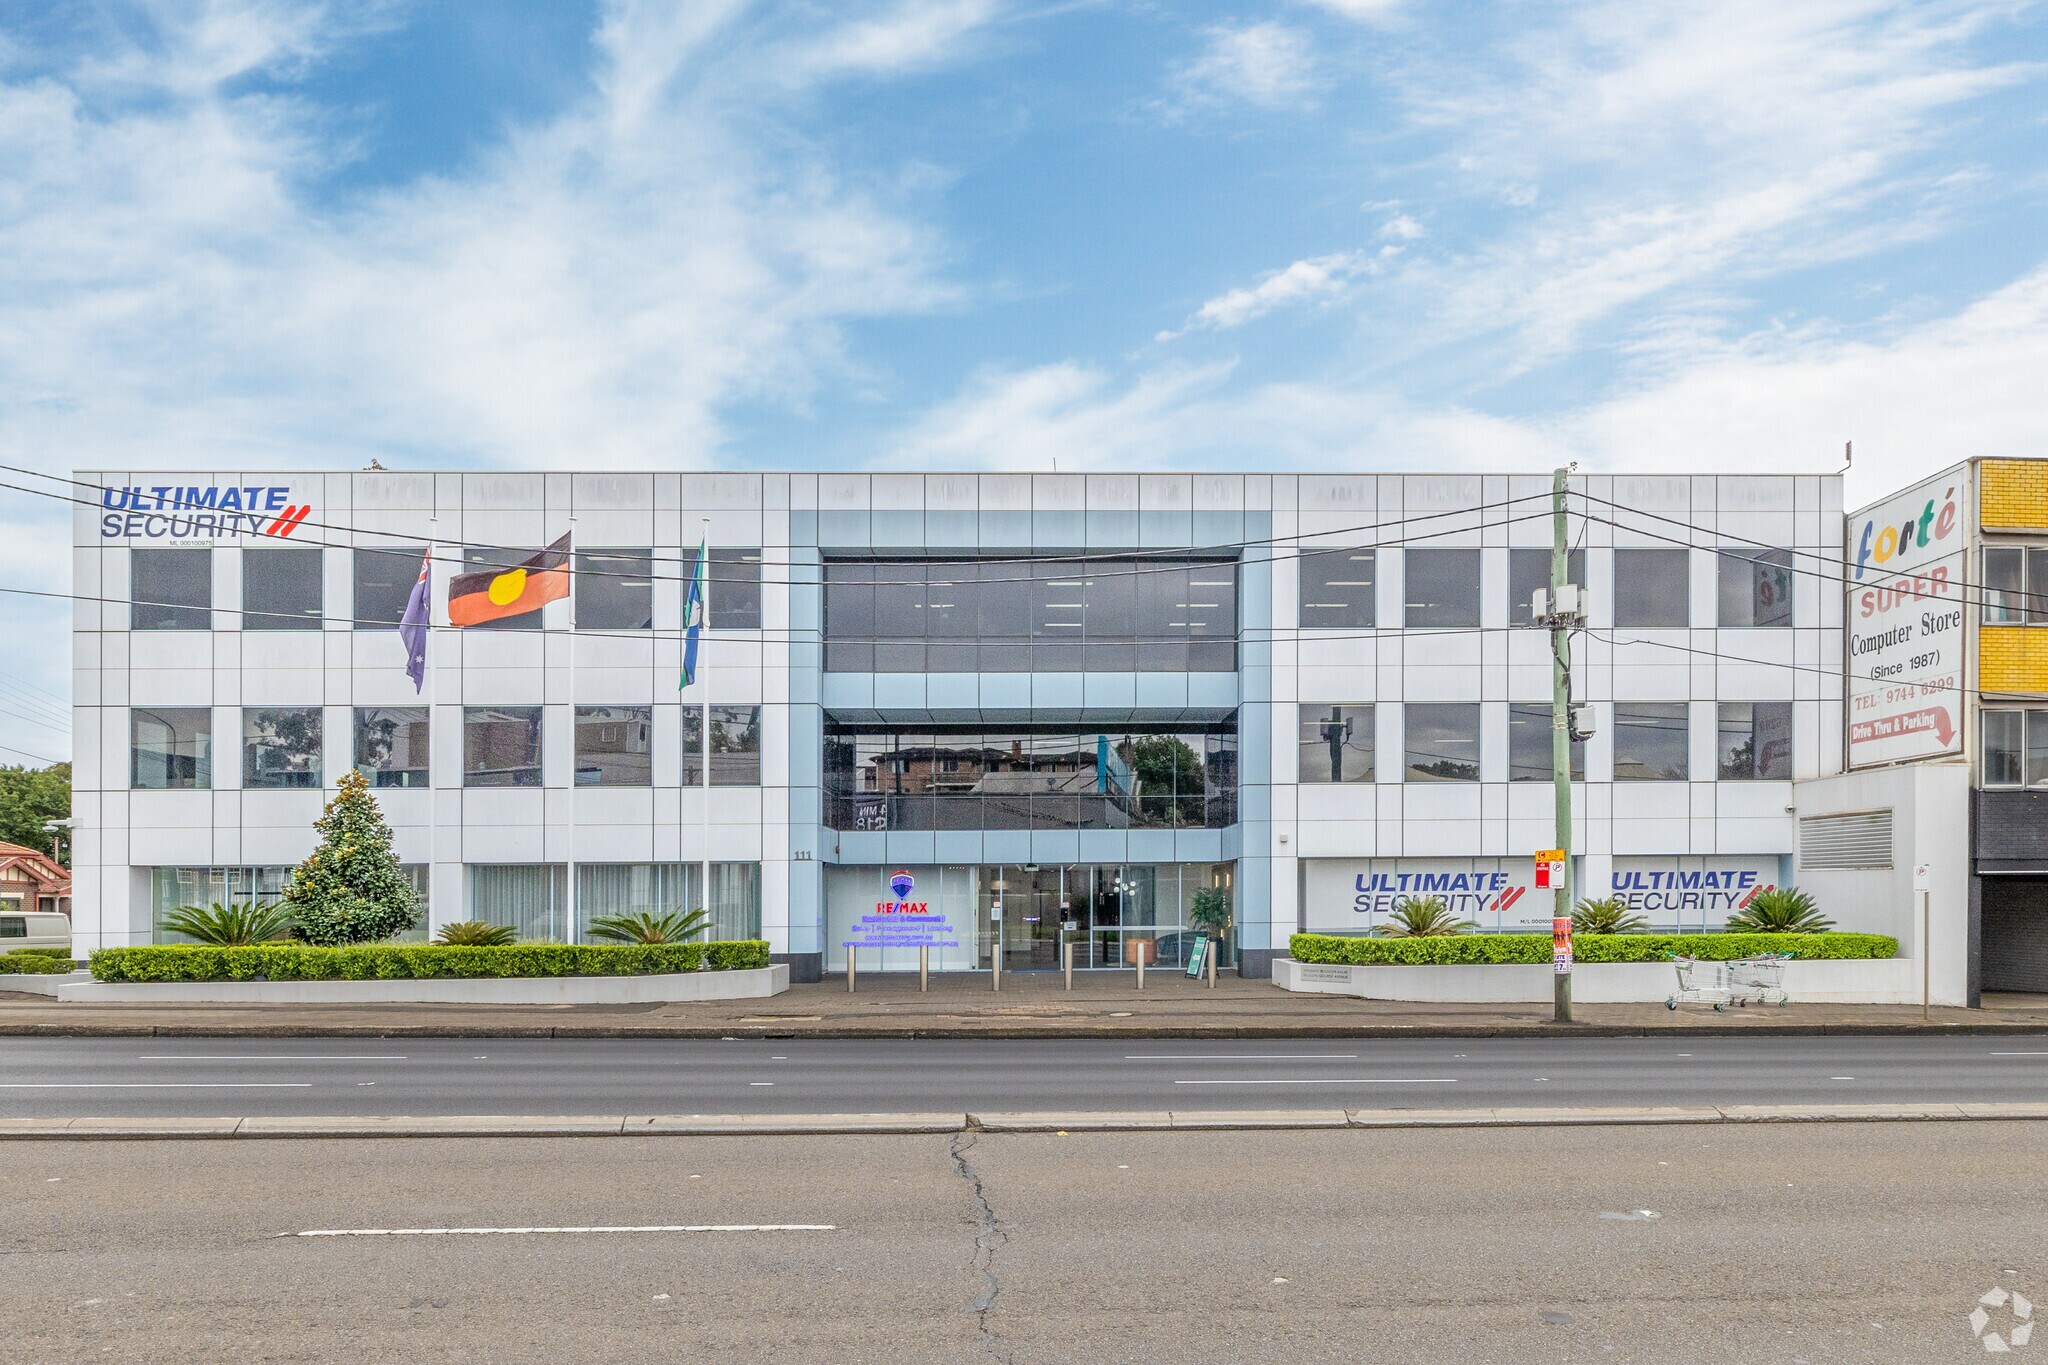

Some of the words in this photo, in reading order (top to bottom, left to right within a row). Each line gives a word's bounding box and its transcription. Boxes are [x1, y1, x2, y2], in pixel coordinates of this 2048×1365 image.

[102, 486, 290, 511] ULTIMATE
[101, 513, 269, 538] SECURITY
[1855, 487, 1956, 580] forté
[1860, 566, 1948, 618] SUPER
[1851, 624, 1913, 656] Computer
[1921, 610, 1960, 636] Store
[1870, 663, 1903, 680] (Since
[1909, 649, 1941, 670] 1987)
[1886, 686, 1915, 704] 9744
[1921, 676, 1954, 696] 6299
[1853, 725, 1872, 740] Drive
[1874, 721, 1892, 736] Thru
[1894, 718, 1901, 732] &
[1903, 713, 1935, 731] Parking
[794, 850, 812, 860] 111
[1355, 872, 1509, 892] ULTIMATE
[1611, 871, 1757, 890] ULTIMATE
[876, 902, 928, 913] RE/MAX
[1353, 894, 1492, 913] SECRITY
[1612, 892, 1741, 910] SECURITY
